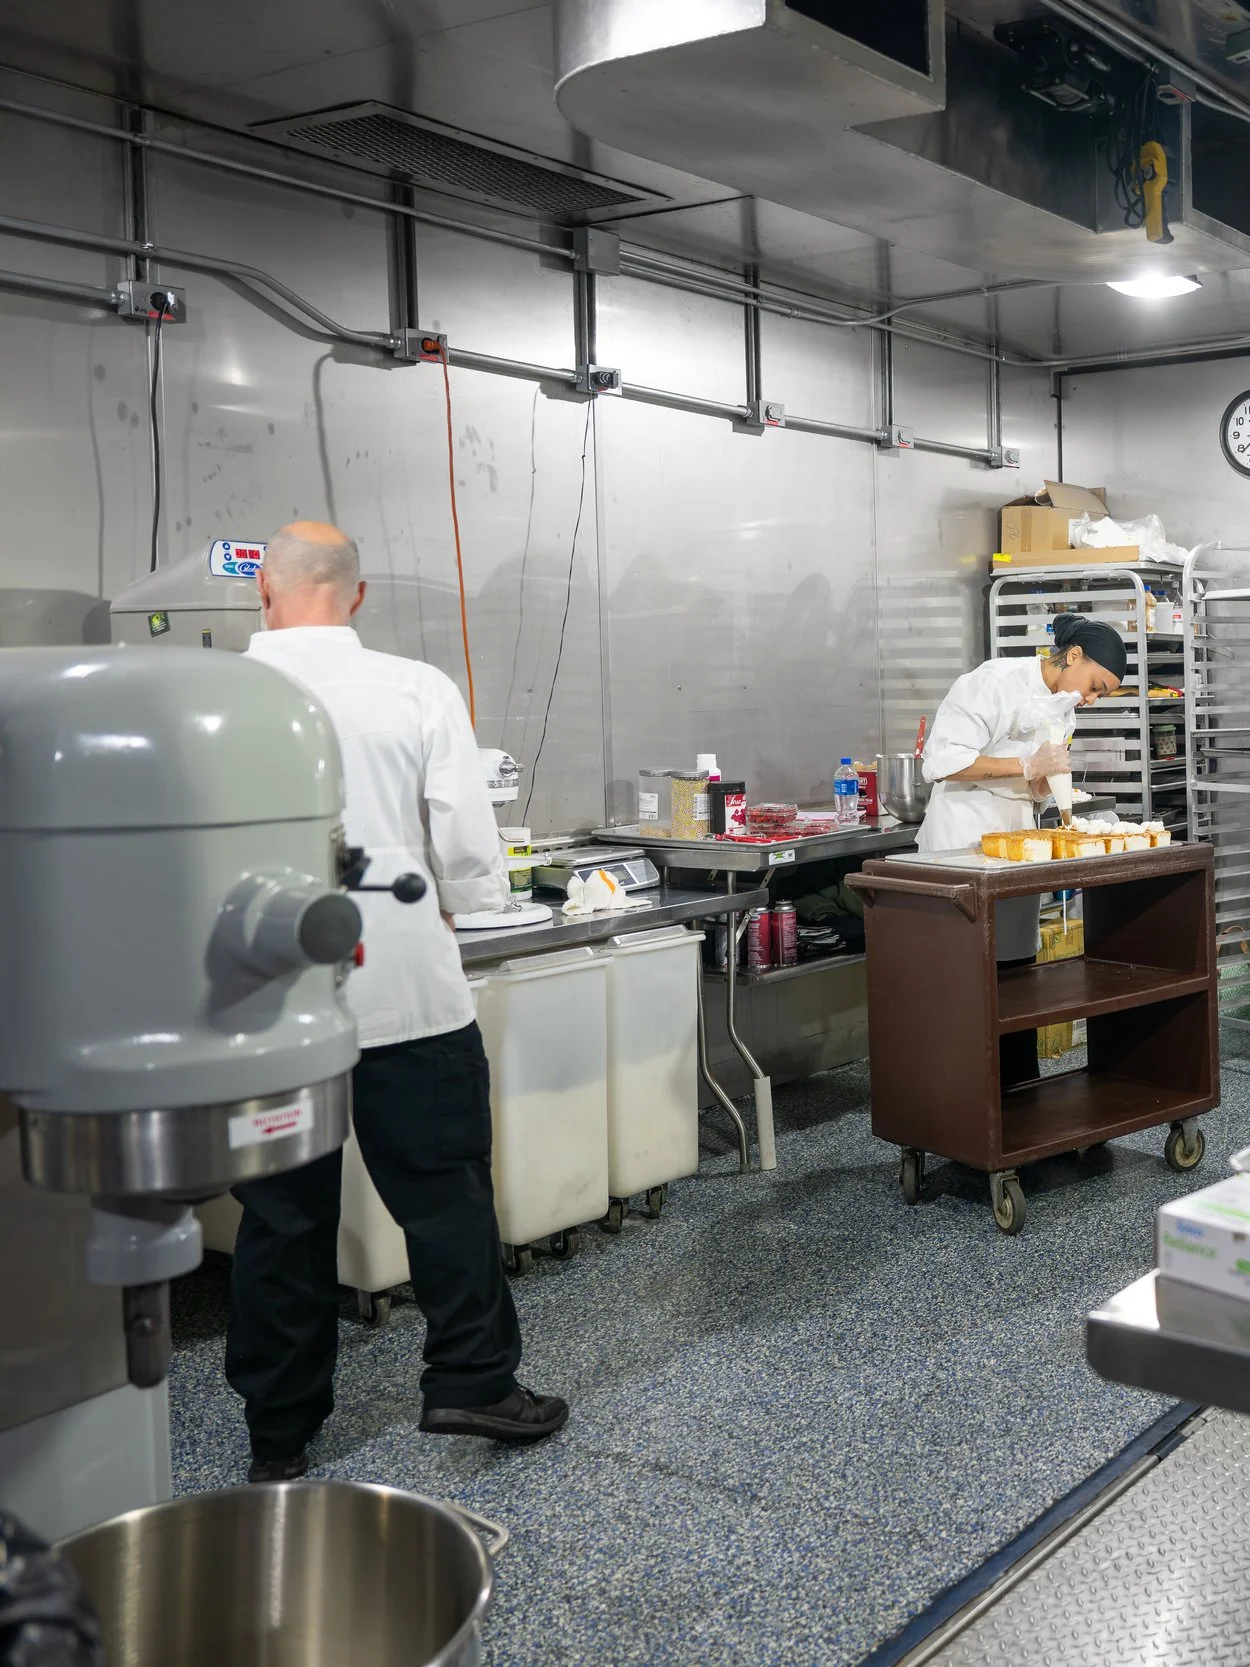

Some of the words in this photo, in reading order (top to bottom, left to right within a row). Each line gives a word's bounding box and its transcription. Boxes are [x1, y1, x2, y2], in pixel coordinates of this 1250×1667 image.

[1245, 406, 1250, 414] 11
[1236, 417, 1244, 426] 10
[1233, 431, 1240, 439] 9
[1237, 444, 1244, 452] 8
